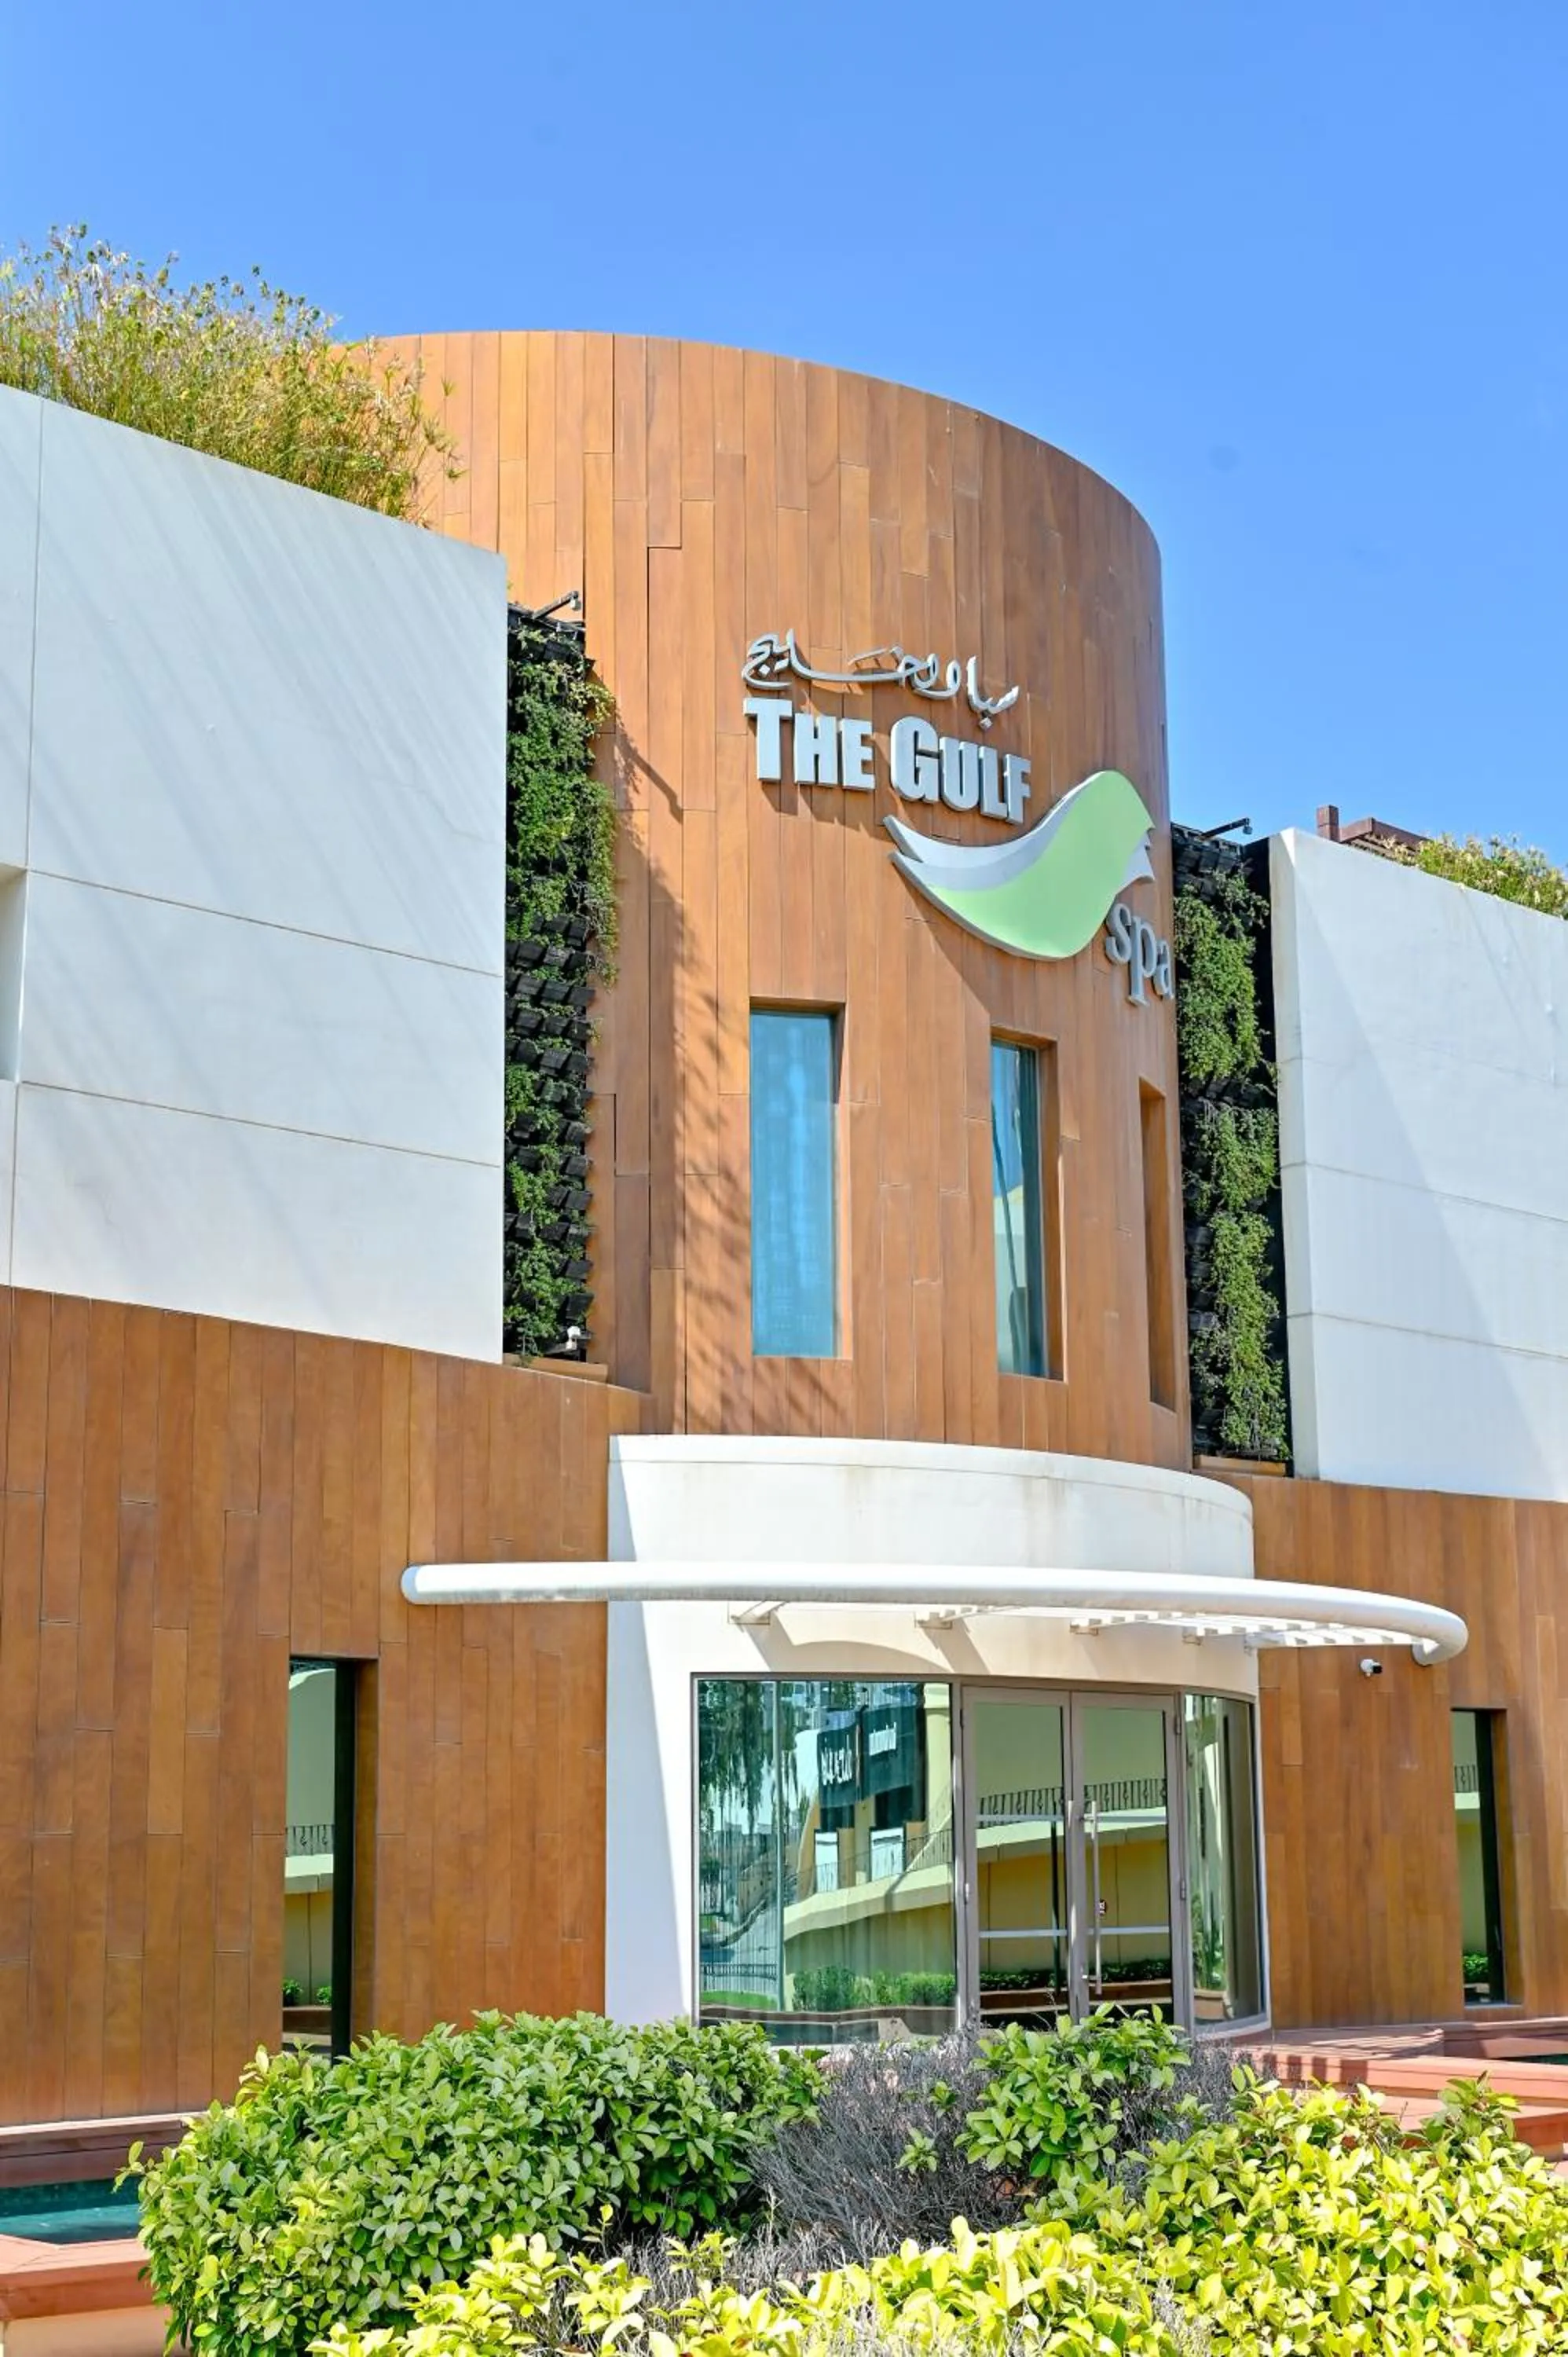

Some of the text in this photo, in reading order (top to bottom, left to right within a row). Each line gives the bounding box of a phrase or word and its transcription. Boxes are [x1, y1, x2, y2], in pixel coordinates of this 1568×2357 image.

[743, 697, 1031, 825] THE GULF
[1105, 903, 1175, 1006] spa
